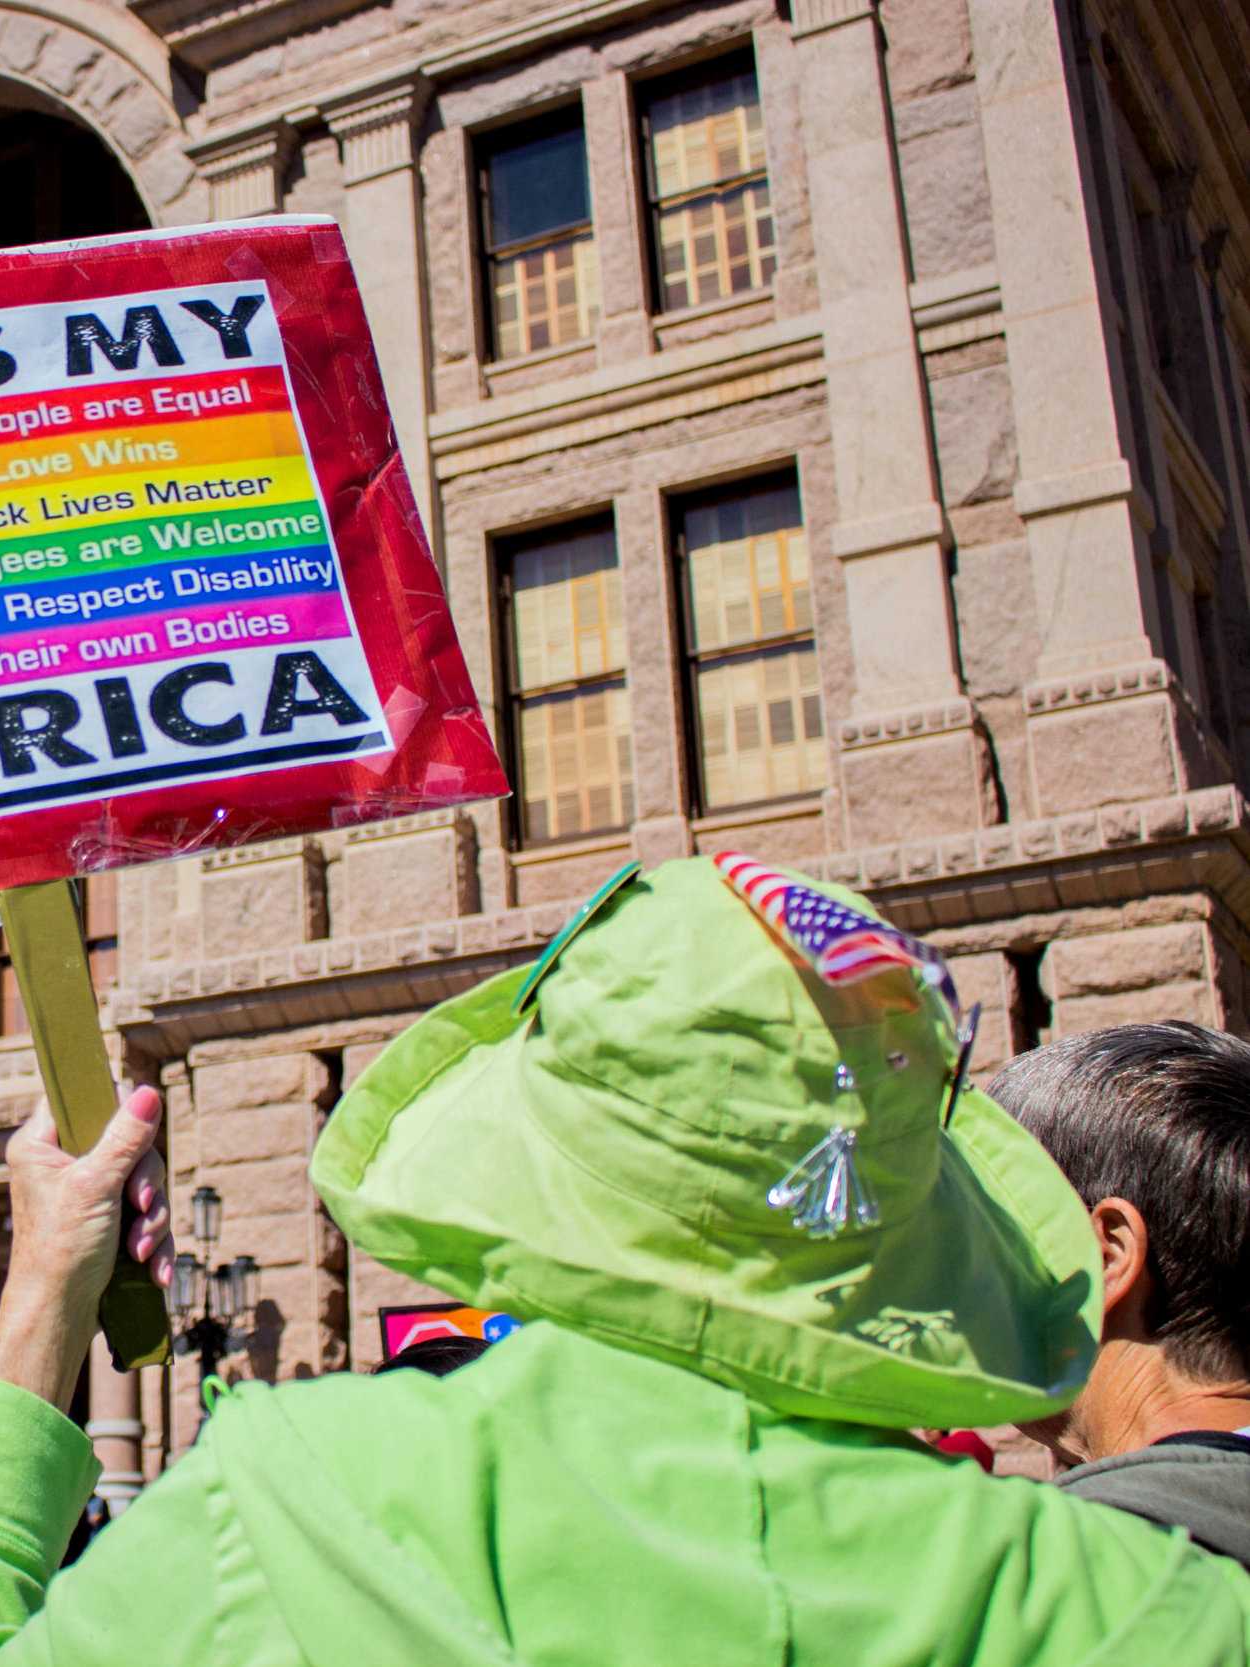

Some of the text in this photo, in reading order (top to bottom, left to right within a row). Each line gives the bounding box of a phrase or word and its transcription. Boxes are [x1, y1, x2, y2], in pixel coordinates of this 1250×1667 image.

[66, 294, 267, 378] MY
[83, 393, 144, 421] are
[151, 378, 252, 417] Equal
[80, 435, 178, 468] Wins
[40, 488, 134, 520] Lives
[144, 473, 273, 506] Matter
[79, 533, 143, 562] are
[148, 512, 321, 552] Welcome
[5, 577, 164, 623] Respect
[171, 555, 335, 596] Disability
[79, 628, 157, 663] own
[165, 608, 290, 649] Bodies
